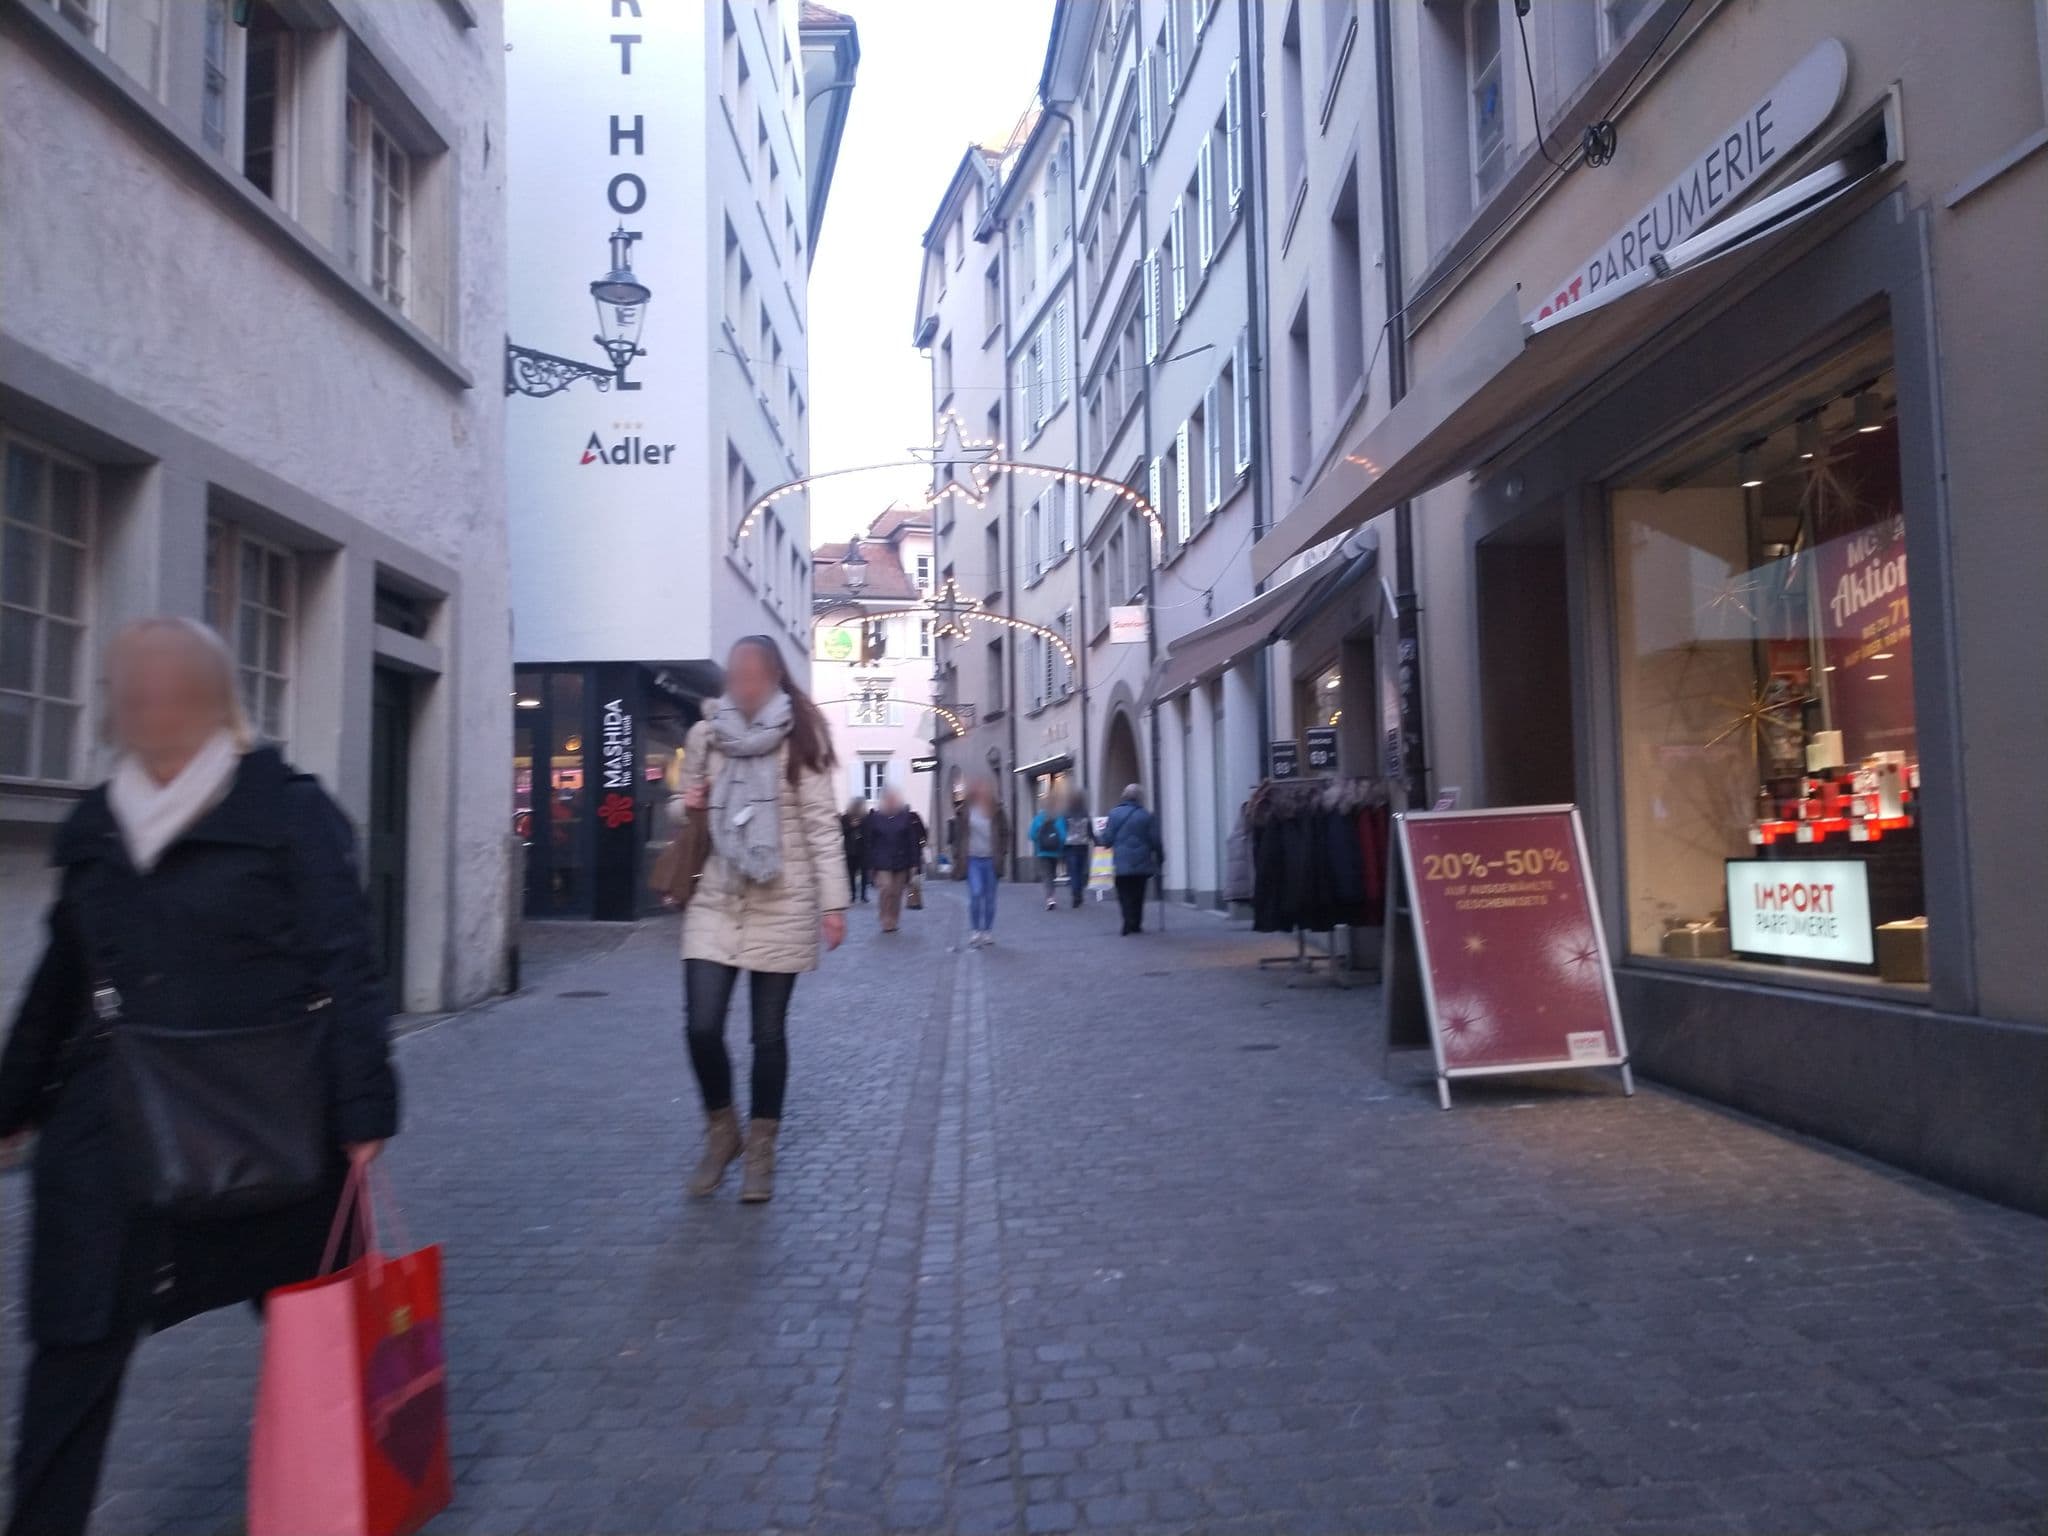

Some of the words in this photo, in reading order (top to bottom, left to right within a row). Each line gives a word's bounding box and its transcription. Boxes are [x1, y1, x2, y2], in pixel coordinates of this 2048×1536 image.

[1589, 100, 1775, 294] PARFUMERIE
[579, 431, 676, 465] Adler
[603, 698, 622, 788] MASHIDA
[1754, 882, 1834, 913] IMPORT
[1755, 913, 1839, 939] PARFUMERIE
